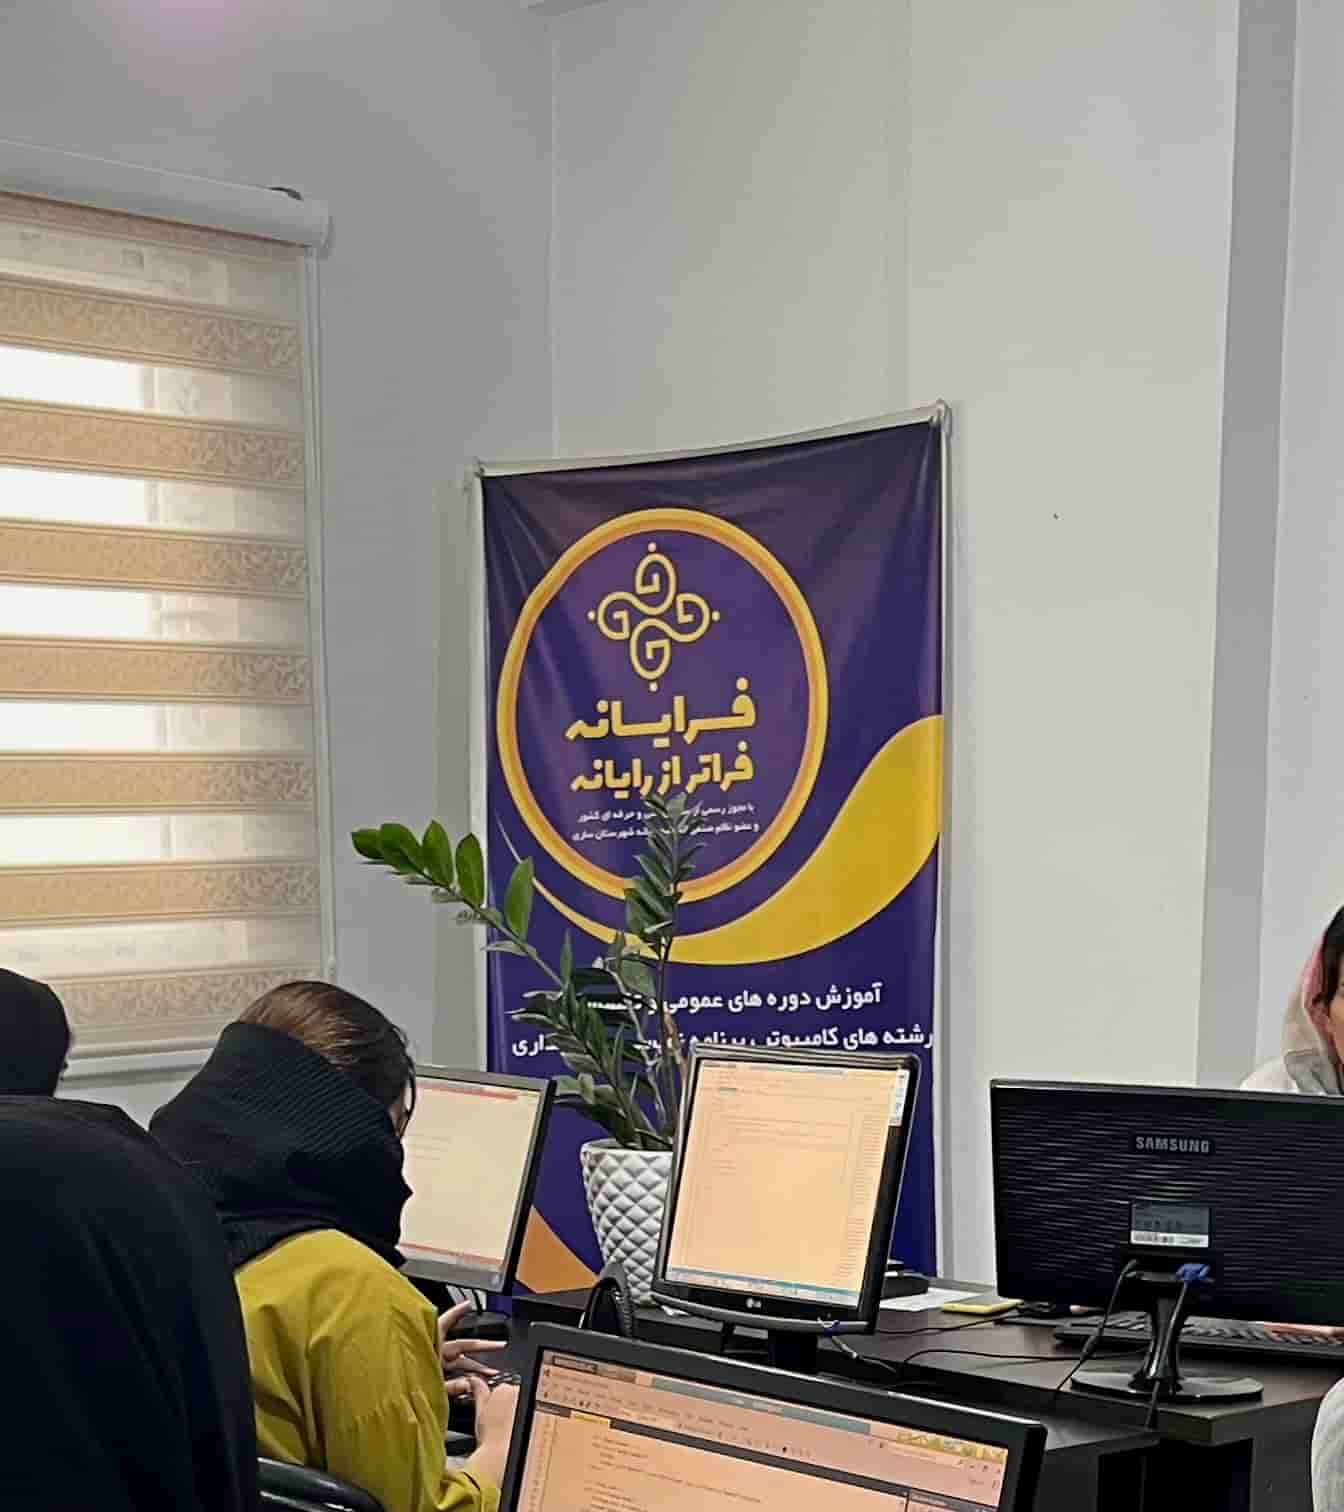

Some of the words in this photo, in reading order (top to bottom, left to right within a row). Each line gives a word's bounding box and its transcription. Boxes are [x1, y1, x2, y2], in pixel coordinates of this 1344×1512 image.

[565, 677, 756, 748] فرایانه
[570, 758, 654, 799] رایانه
[657, 755, 681, 795] از
[685, 741, 754, 794] فراتر
[663, 995, 724, 1014] عمومی
[727, 989, 763, 1013] های
[766, 991, 811, 1012] دوره
[815, 981, 884, 1011] آموزش
[843, 1027, 879, 1051] های
[882, 1023, 934, 1049] رشته
[1135, 1135, 1210, 1154] SAMSUNG
